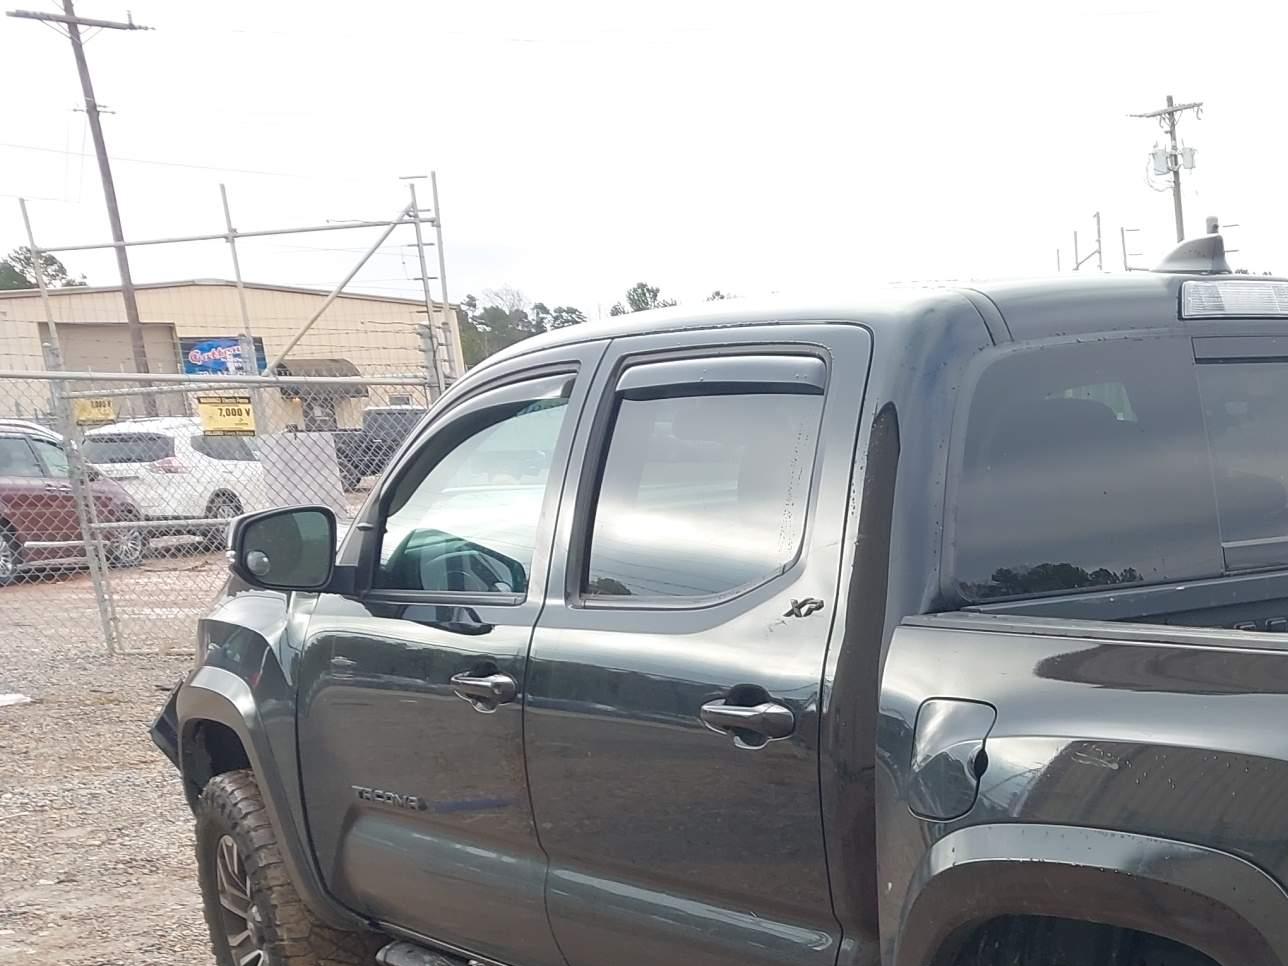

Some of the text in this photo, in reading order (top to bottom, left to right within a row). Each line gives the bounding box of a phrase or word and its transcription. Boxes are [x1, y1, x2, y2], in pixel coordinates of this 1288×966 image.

[218, 408, 251, 417] 7,000 V
[783, 598, 824, 617] XP
[351, 785, 427, 811] TACOMA
